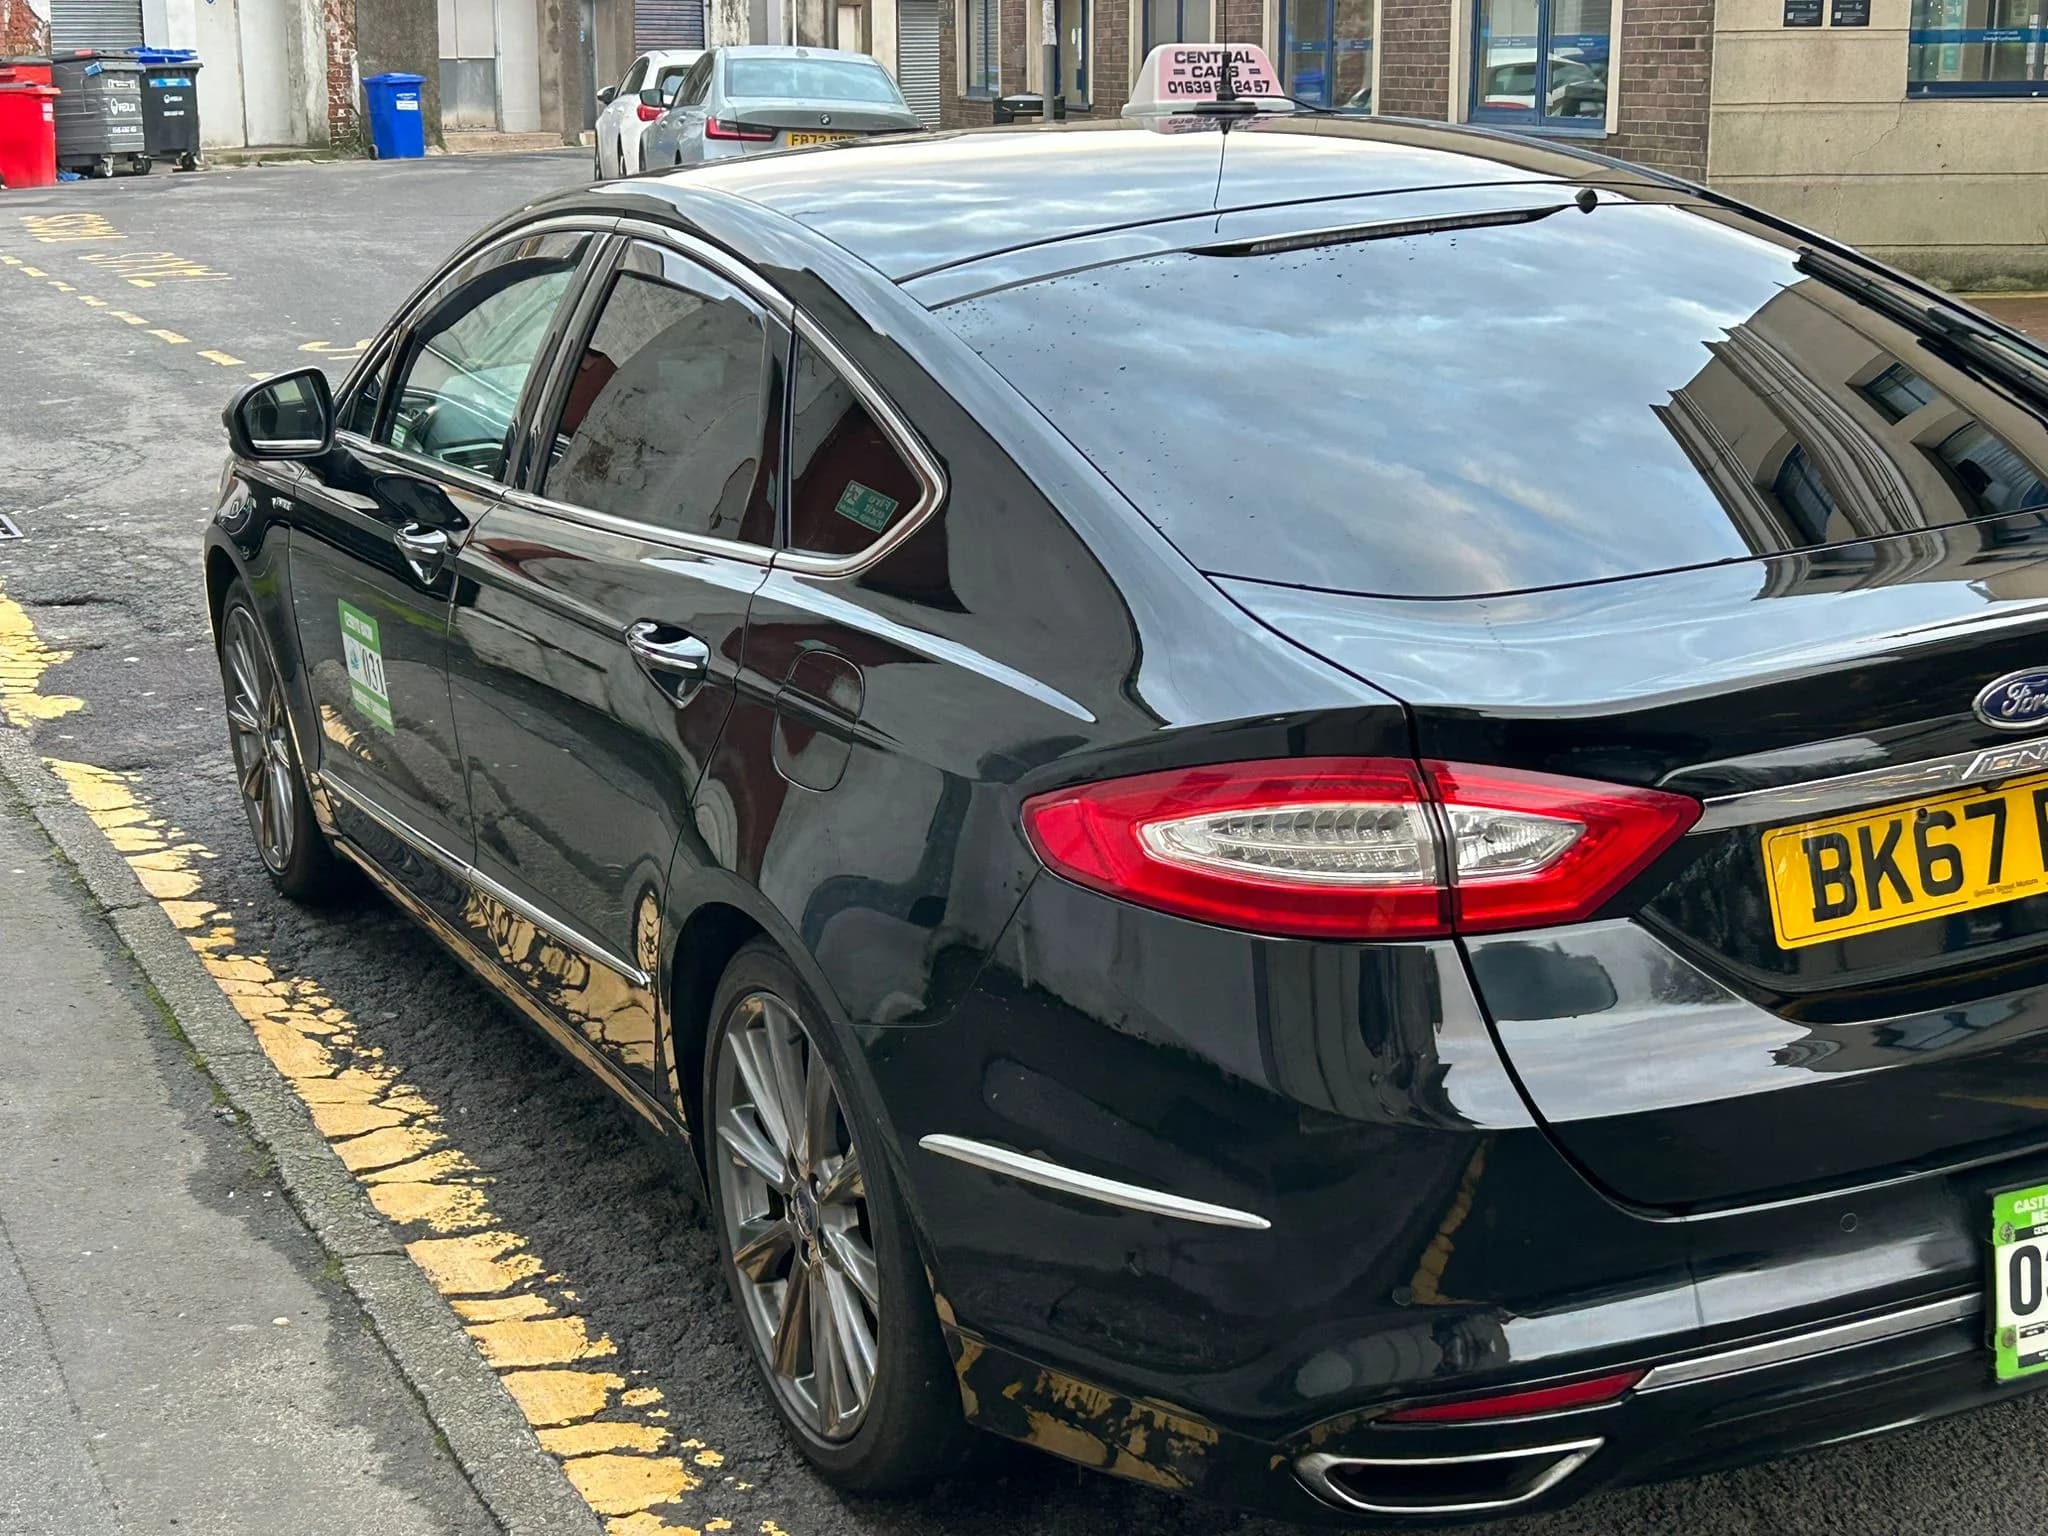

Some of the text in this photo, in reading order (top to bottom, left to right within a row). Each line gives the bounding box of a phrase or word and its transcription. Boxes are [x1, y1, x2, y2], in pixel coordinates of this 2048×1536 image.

[1168, 80, 1270, 94] 01639 62457
[1191, 66, 1239, 78] CAS
[2001, 679, 2048, 717] For
[1801, 798, 2007, 923] BK67
[2009, 1245, 2048, 1316] 0
